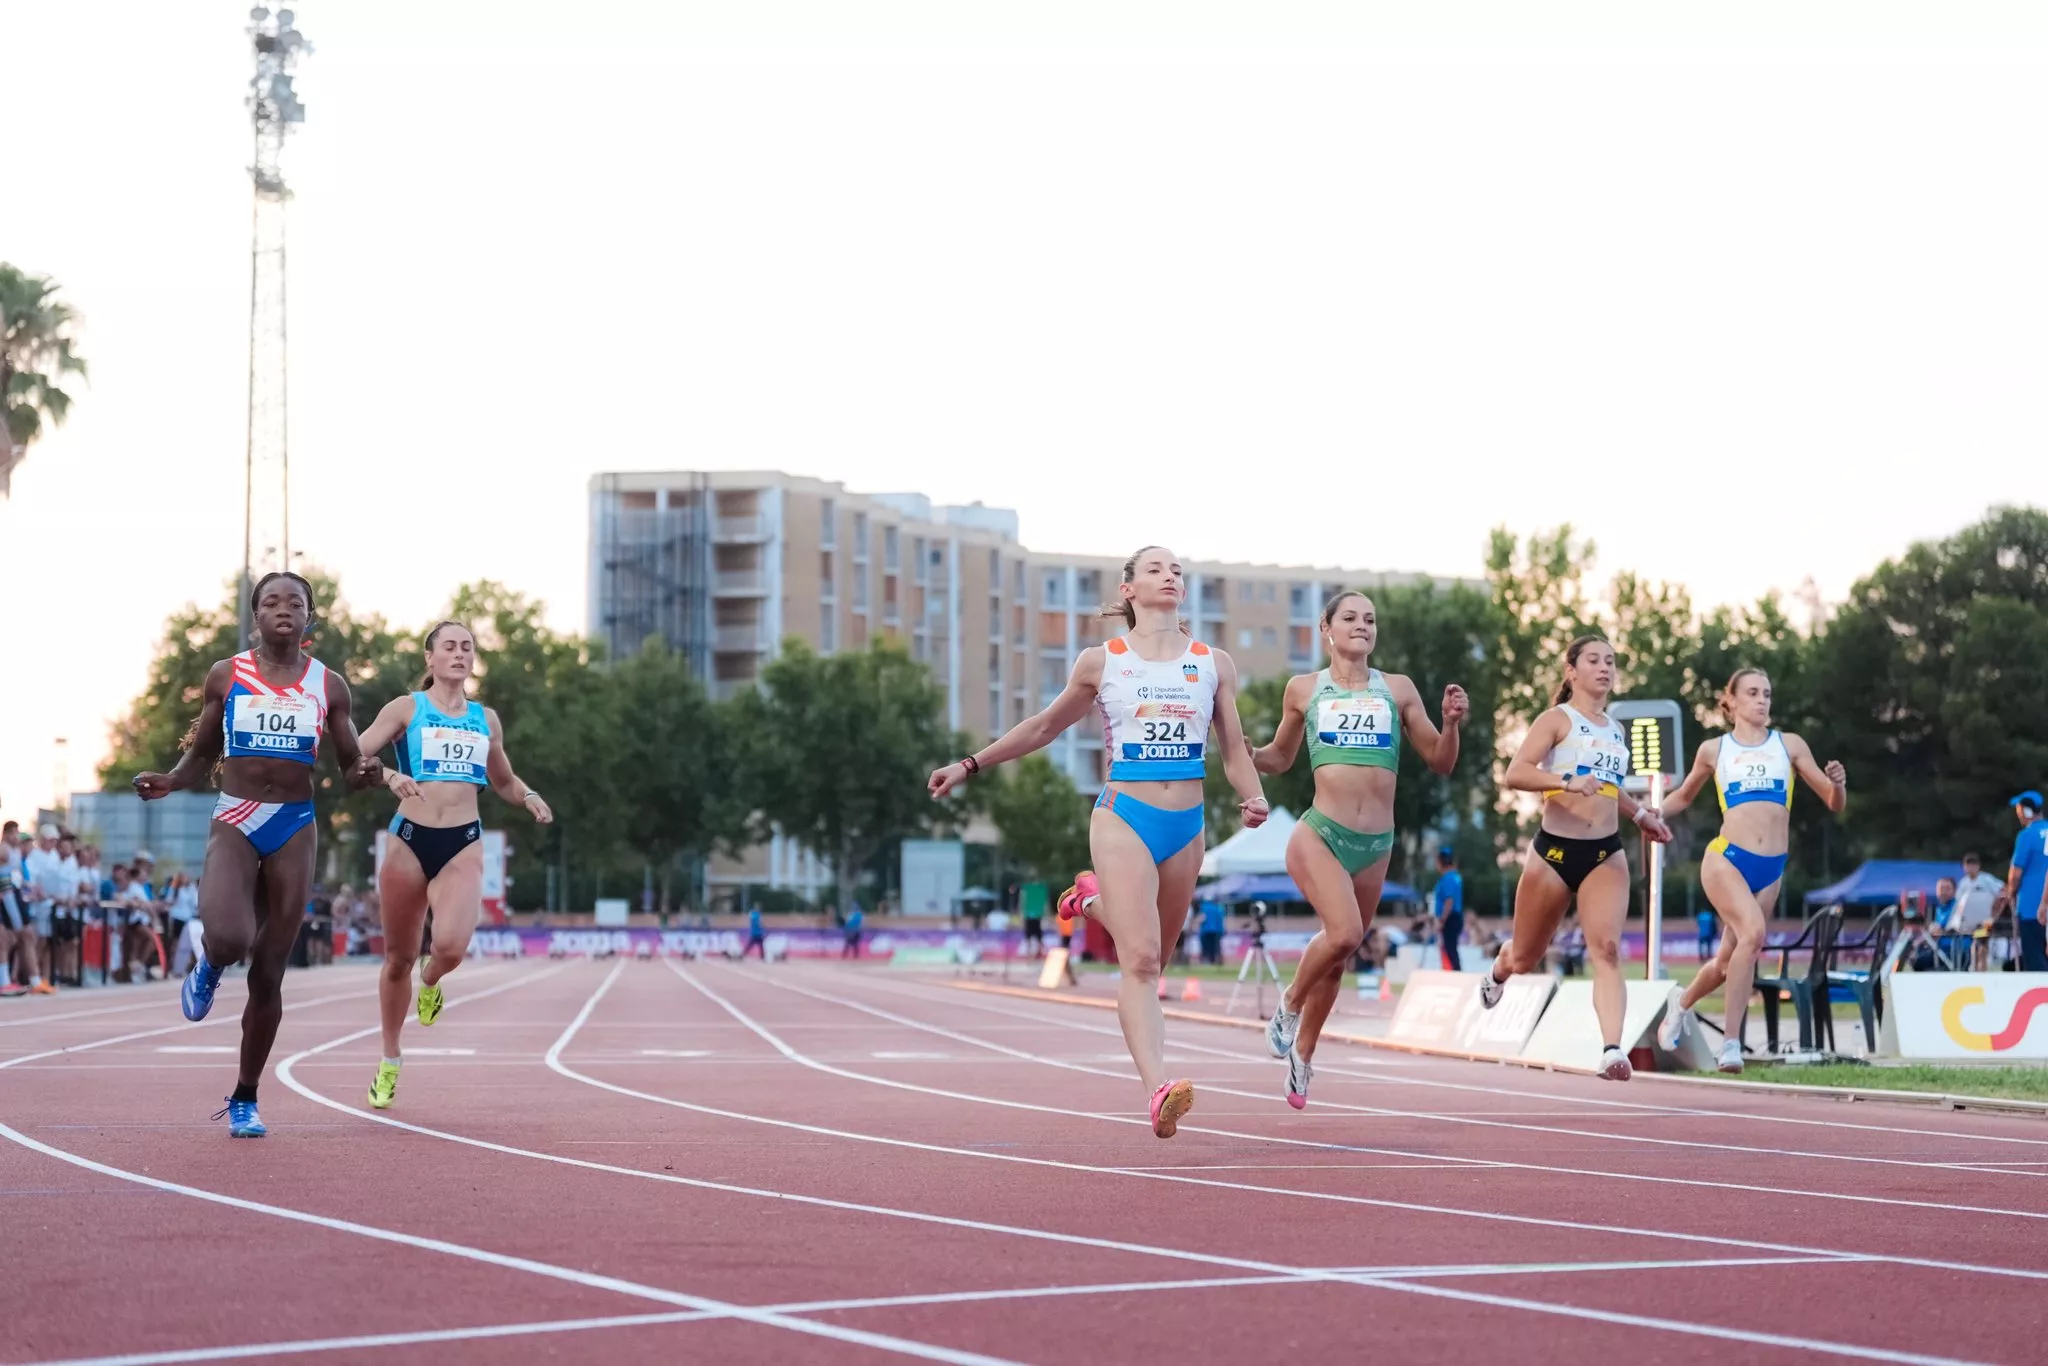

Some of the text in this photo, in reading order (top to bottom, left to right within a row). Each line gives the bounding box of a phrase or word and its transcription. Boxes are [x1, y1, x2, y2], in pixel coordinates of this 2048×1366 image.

[255, 713, 297, 733] 104
[1337, 714, 1376, 731] 274
[1144, 722, 1187, 742] 324
[441, 743, 474, 760] 197
[1594, 752, 1621, 771] 218
[1746, 764, 1766, 777] 29
